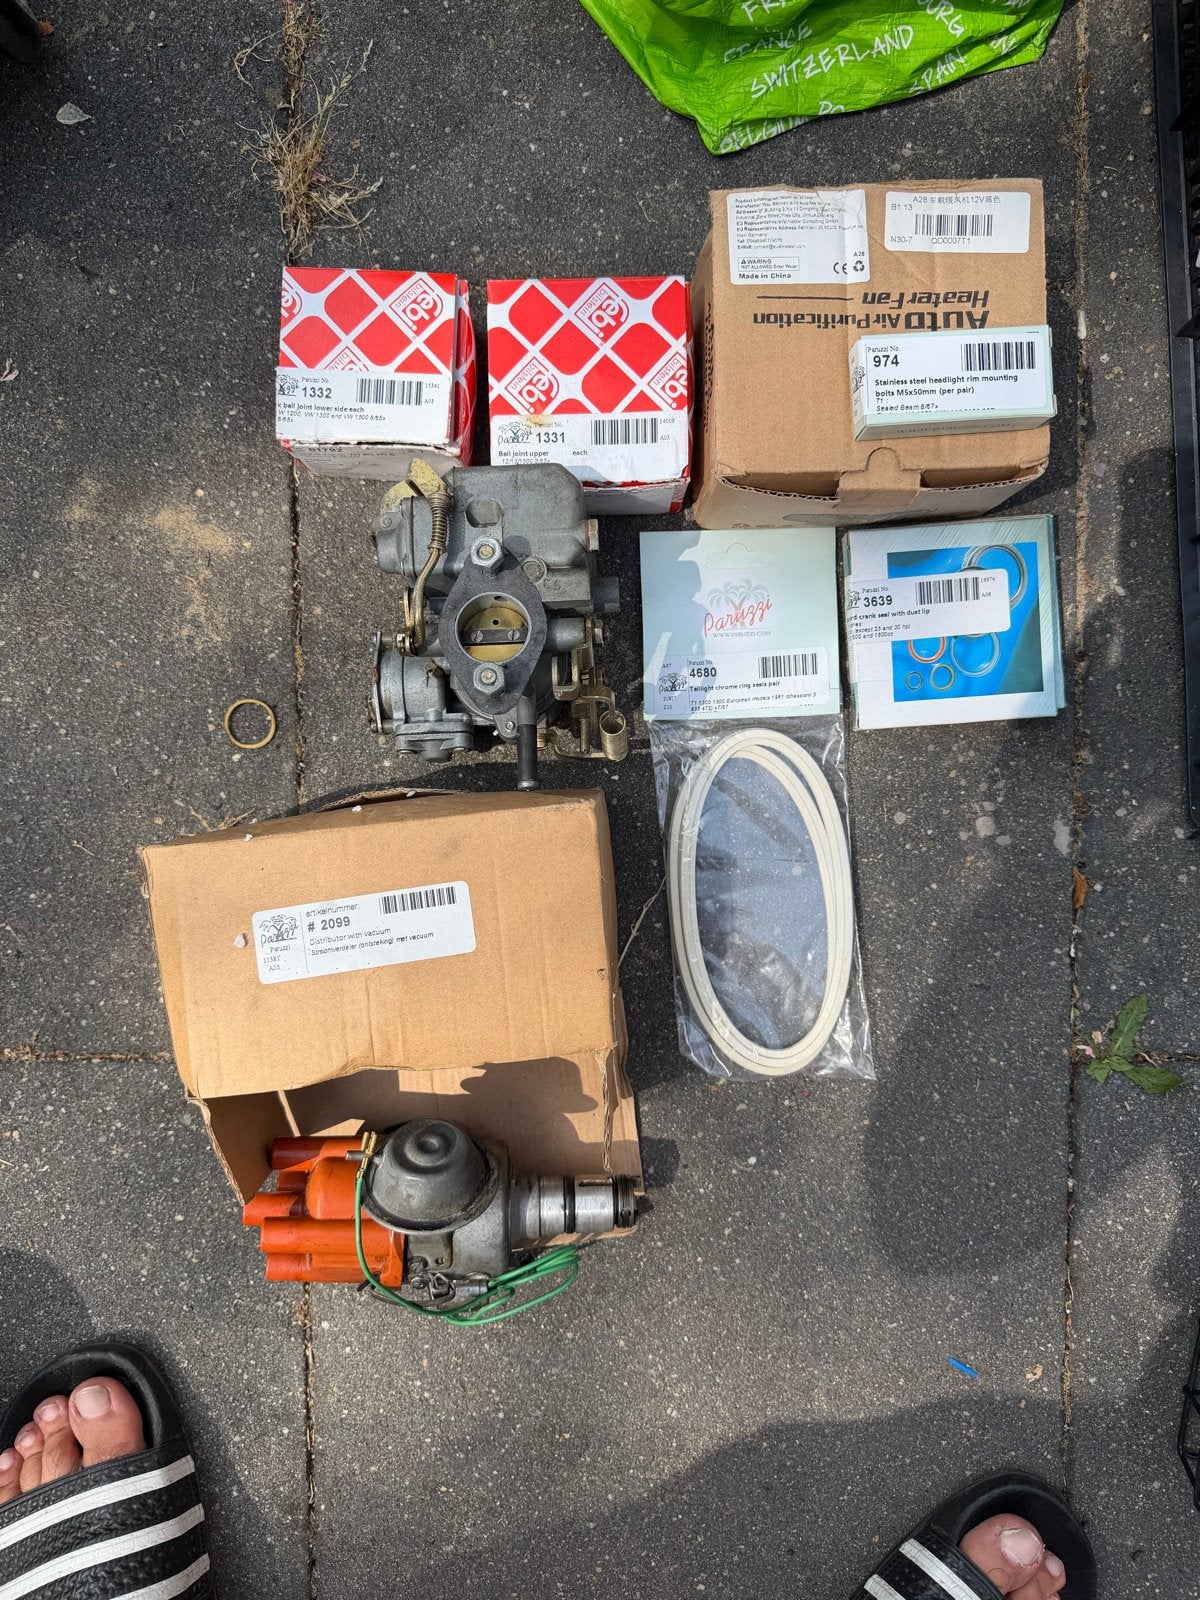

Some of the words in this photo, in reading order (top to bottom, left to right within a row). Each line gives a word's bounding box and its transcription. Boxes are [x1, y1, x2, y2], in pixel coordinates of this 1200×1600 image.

[750, 24, 914, 99] SWITZERLAND
[908, 47, 966, 96] SPAIN
[891, 203, 913, 211] B1.13
[890, 235, 913, 244] N30-7
[395, 282, 424, 309] bilstein
[580, 287, 609, 315] bilstein
[862, 291, 905, 309] Fan
[907, 290, 990, 308] Heater
[401, 287, 444, 331] febi
[588, 294, 629, 338] febi
[753, 313, 870, 329] Purification
[872, 313, 901, 328] Air
[867, 345, 889, 353] Paruzzi
[872, 354, 900, 368] 974
[510, 362, 539, 390] bilstein
[653, 357, 683, 386] bilstein
[874, 378, 908, 387] Stainless
[909, 377, 927, 385] steel
[928, 375, 965, 385] headlight
[966, 374, 980, 382] rim
[981, 373, 1018, 383] mounting
[301, 386, 332, 399] 1332
[516, 369, 559, 414] febi
[875, 389, 895, 398] bolts
[896, 388, 937, 396] M5x50mm
[939, 387, 955, 396] (per
[956, 386, 975, 395] pair)
[283, 401, 296, 409] ball
[297, 402, 313, 411] joint
[314, 403, 333, 411] lower
[334, 404, 348, 412] side
[876, 404, 899, 412] Sealed
[900, 403, 920, 411] Beam
[536, 432, 565, 444] 1331
[512, 450, 528, 458] joint
[864, 594, 893, 607] 3639
[703, 594, 773, 638] Paruzzi
[891, 609, 906, 617] with
[906, 607, 921, 616] dust
[921, 608, 931, 617] lip
[689, 667, 717, 678] 4680
[738, 682, 751, 690] ring
[768, 680, 781, 688] pair
[305, 903, 361, 918] artikelnummer:
[307, 921, 316, 933] #
[320, 916, 351, 931] 2099
[309, 933, 346, 946] Distributor
[348, 931, 363, 939] with
[363, 927, 392, 937] vacuum
[409, 932, 434, 941] vacuum
[269, 945, 291, 953] Paruzzi
